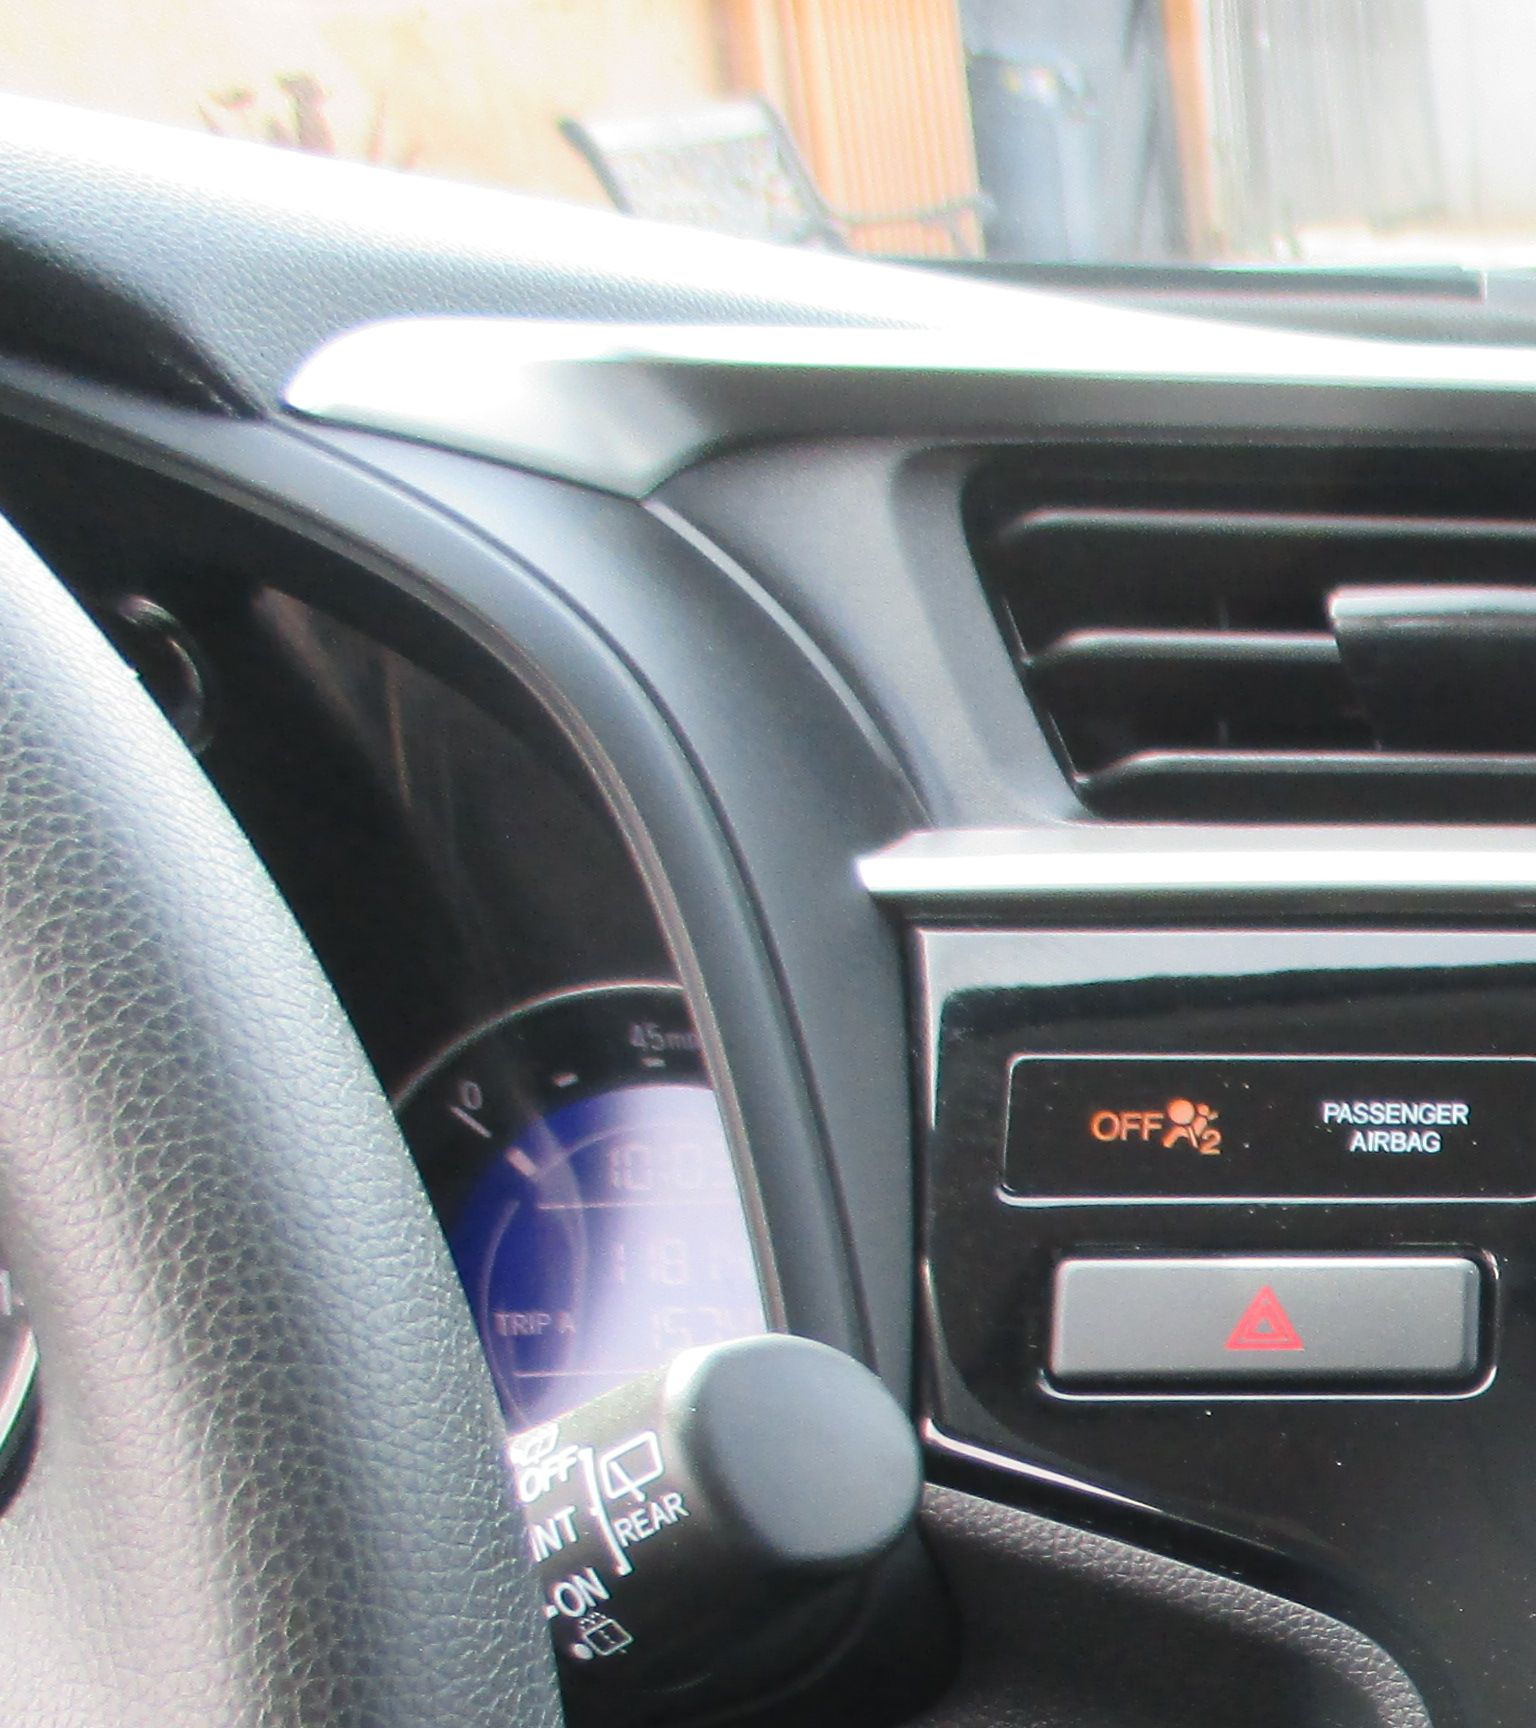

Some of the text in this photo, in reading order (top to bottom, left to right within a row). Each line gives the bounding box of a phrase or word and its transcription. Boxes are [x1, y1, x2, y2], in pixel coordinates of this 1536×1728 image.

[1090, 1110, 1162, 1142] OFF
[1322, 1101, 1469, 1125] PASSENGER
[1349, 1129, 1441, 1153] AIRBAG
[494, 1313, 551, 1336] TRIP
[519, 1446, 579, 1502] OFF
[529, 1505, 578, 1562] INT
[612, 1492, 690, 1548] REAR
